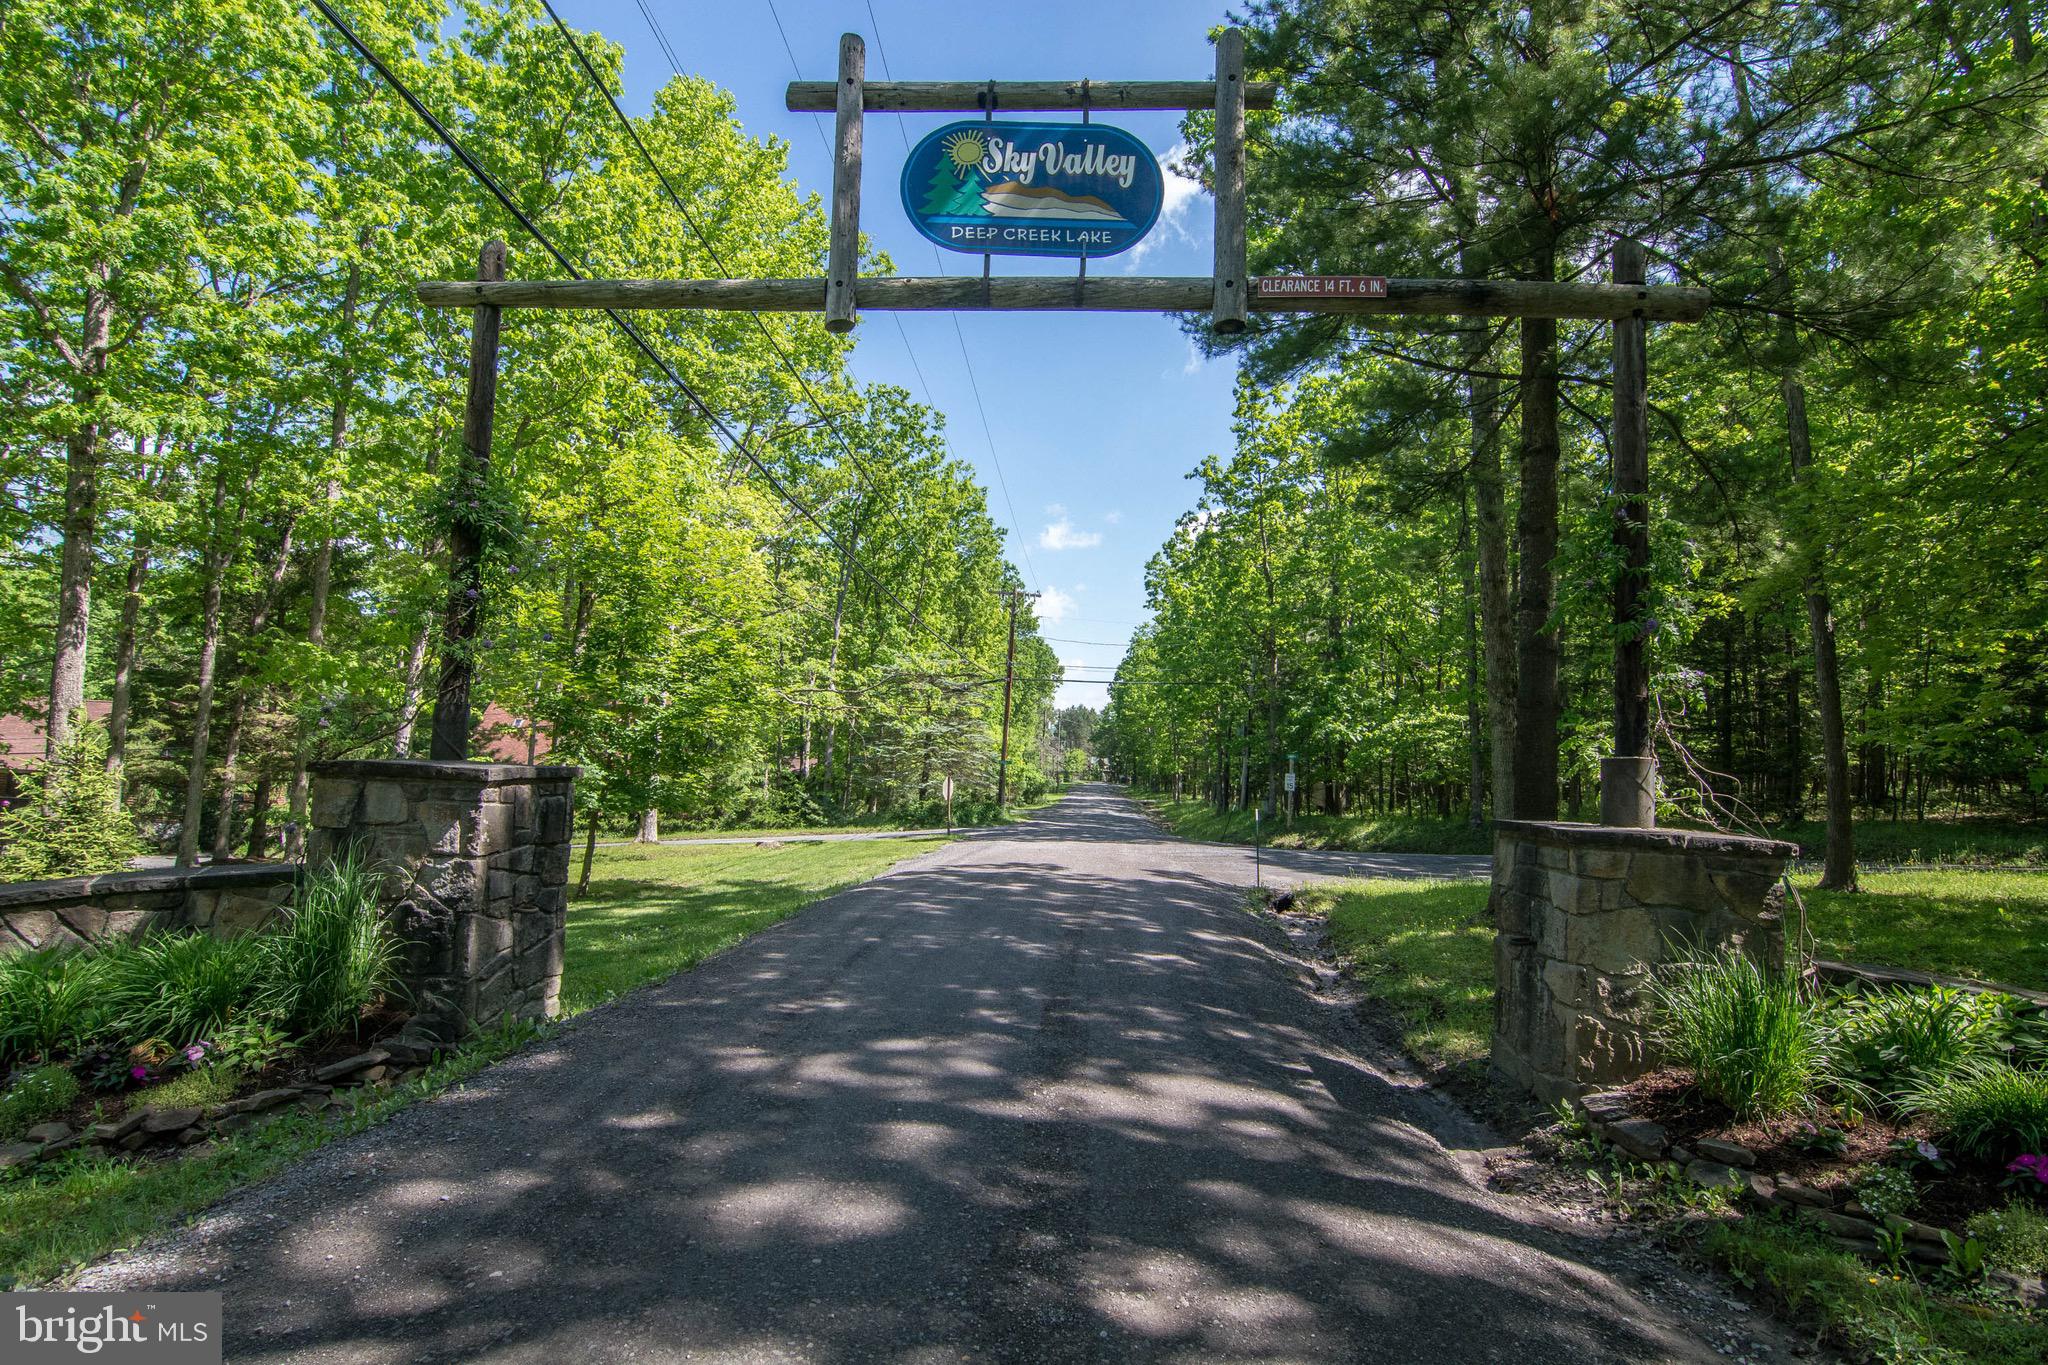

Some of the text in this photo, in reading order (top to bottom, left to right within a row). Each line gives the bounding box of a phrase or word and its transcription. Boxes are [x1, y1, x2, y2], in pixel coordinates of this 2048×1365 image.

[983, 137, 1136, 188] Sky Valley
[951, 226, 1112, 243] DEEP CREEK LAKE
[1262, 279, 1383, 293] CLEARANCE 14 FT. 6 IN.
